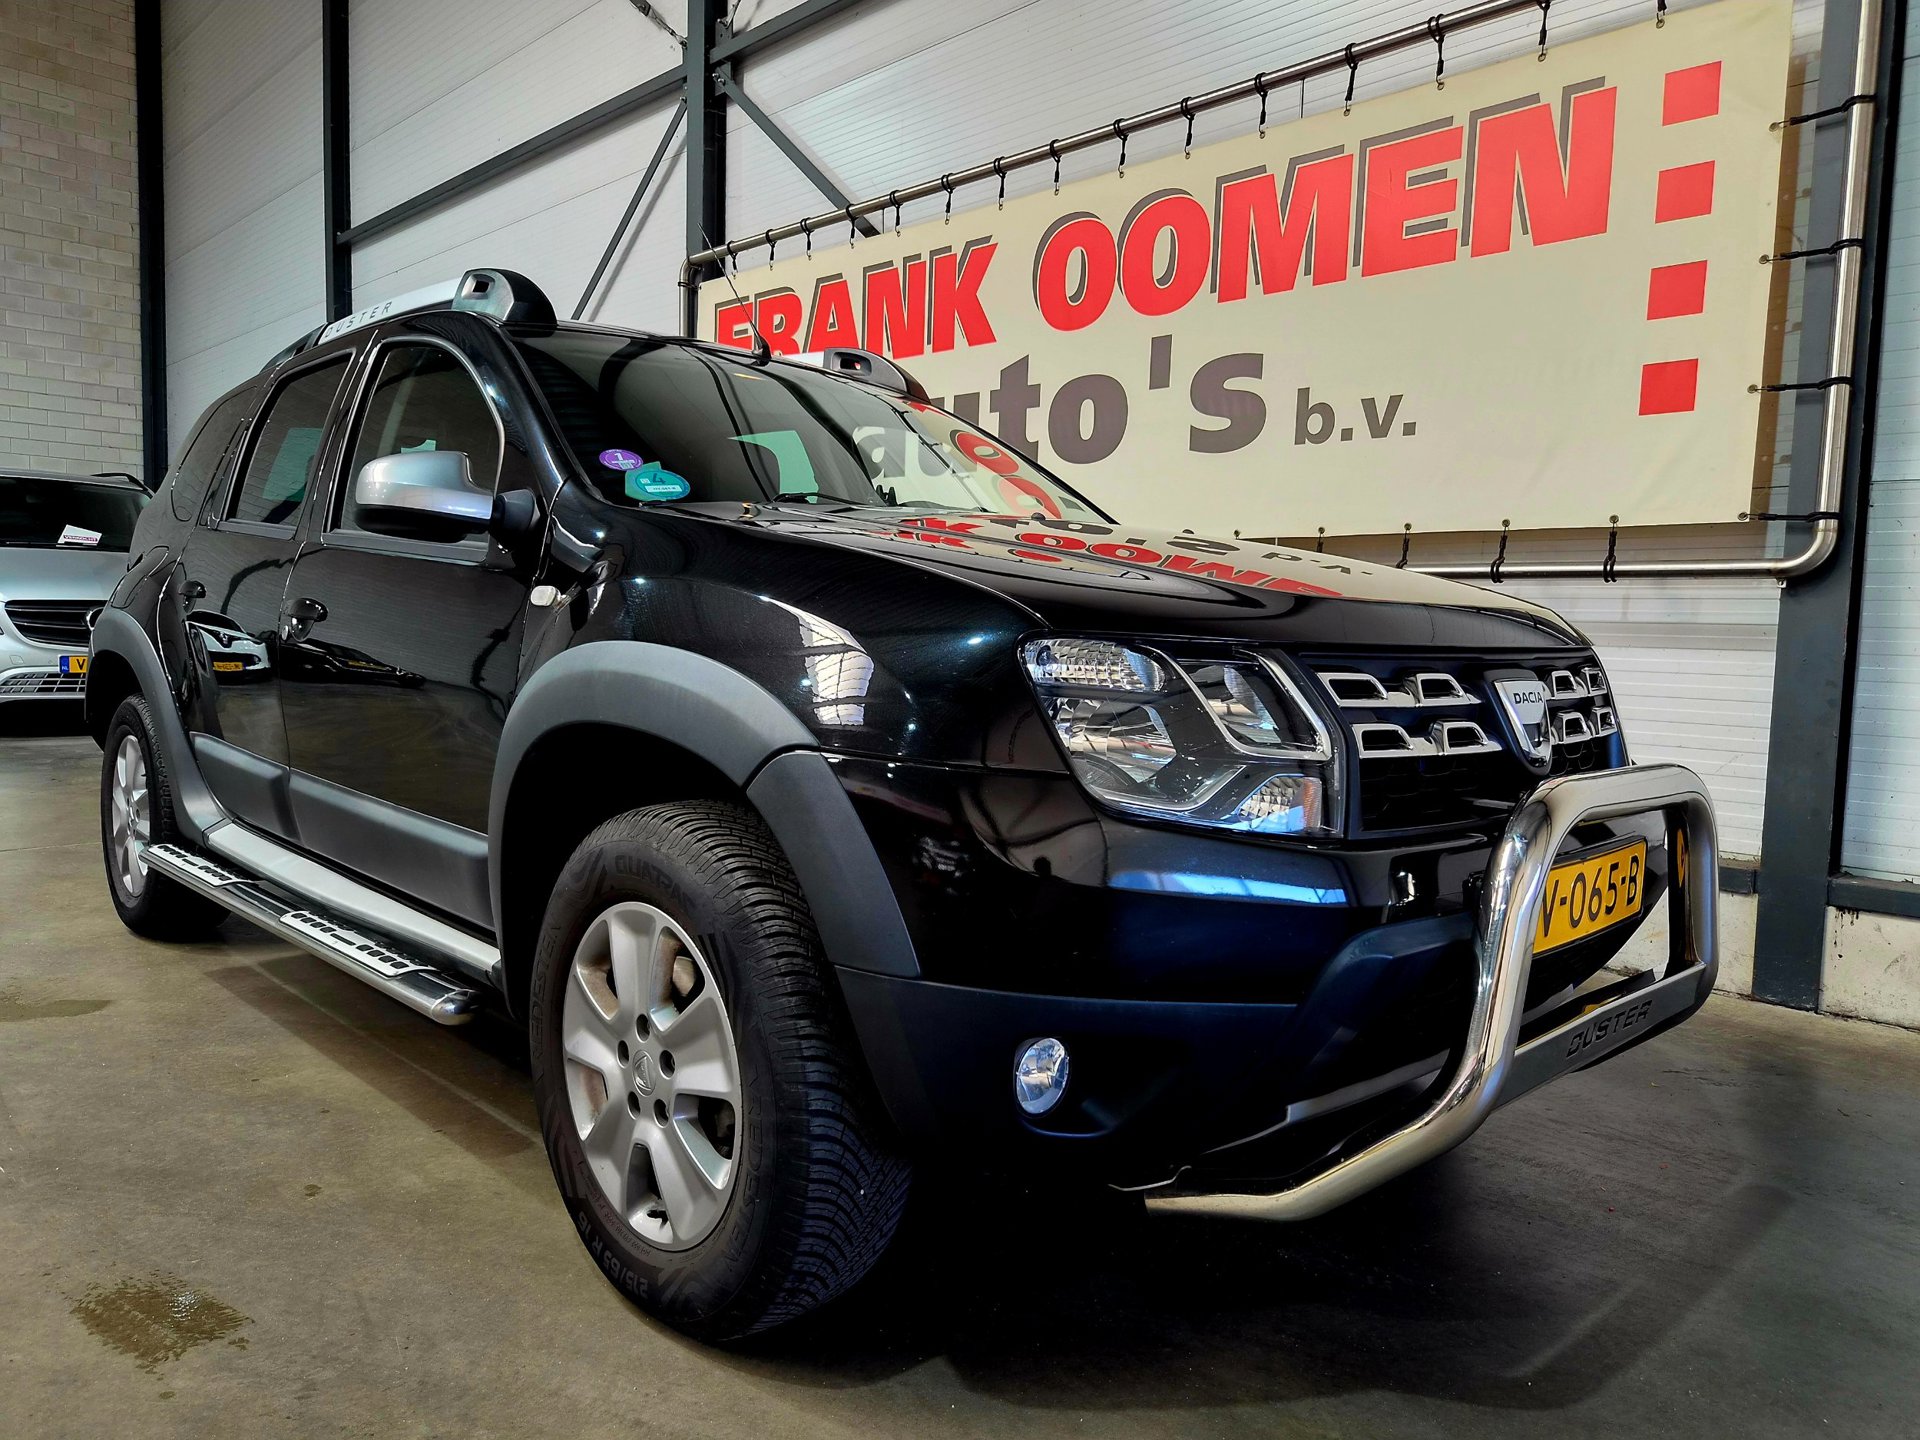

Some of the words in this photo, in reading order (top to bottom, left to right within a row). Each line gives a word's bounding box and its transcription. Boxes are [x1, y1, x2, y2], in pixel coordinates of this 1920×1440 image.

[714, 234, 999, 360] FRANK
[1032, 75, 1618, 332] OOMEN
[324, 300, 393, 338] DUSTER
[1294, 387, 1417, 446] b.v.
[1513, 691, 1544, 705] DACIA
[1565, 999, 1653, 1058] DUSTER
[577, 1210, 592, 1239] 16
[601, 1250, 650, 1300] 215/65
